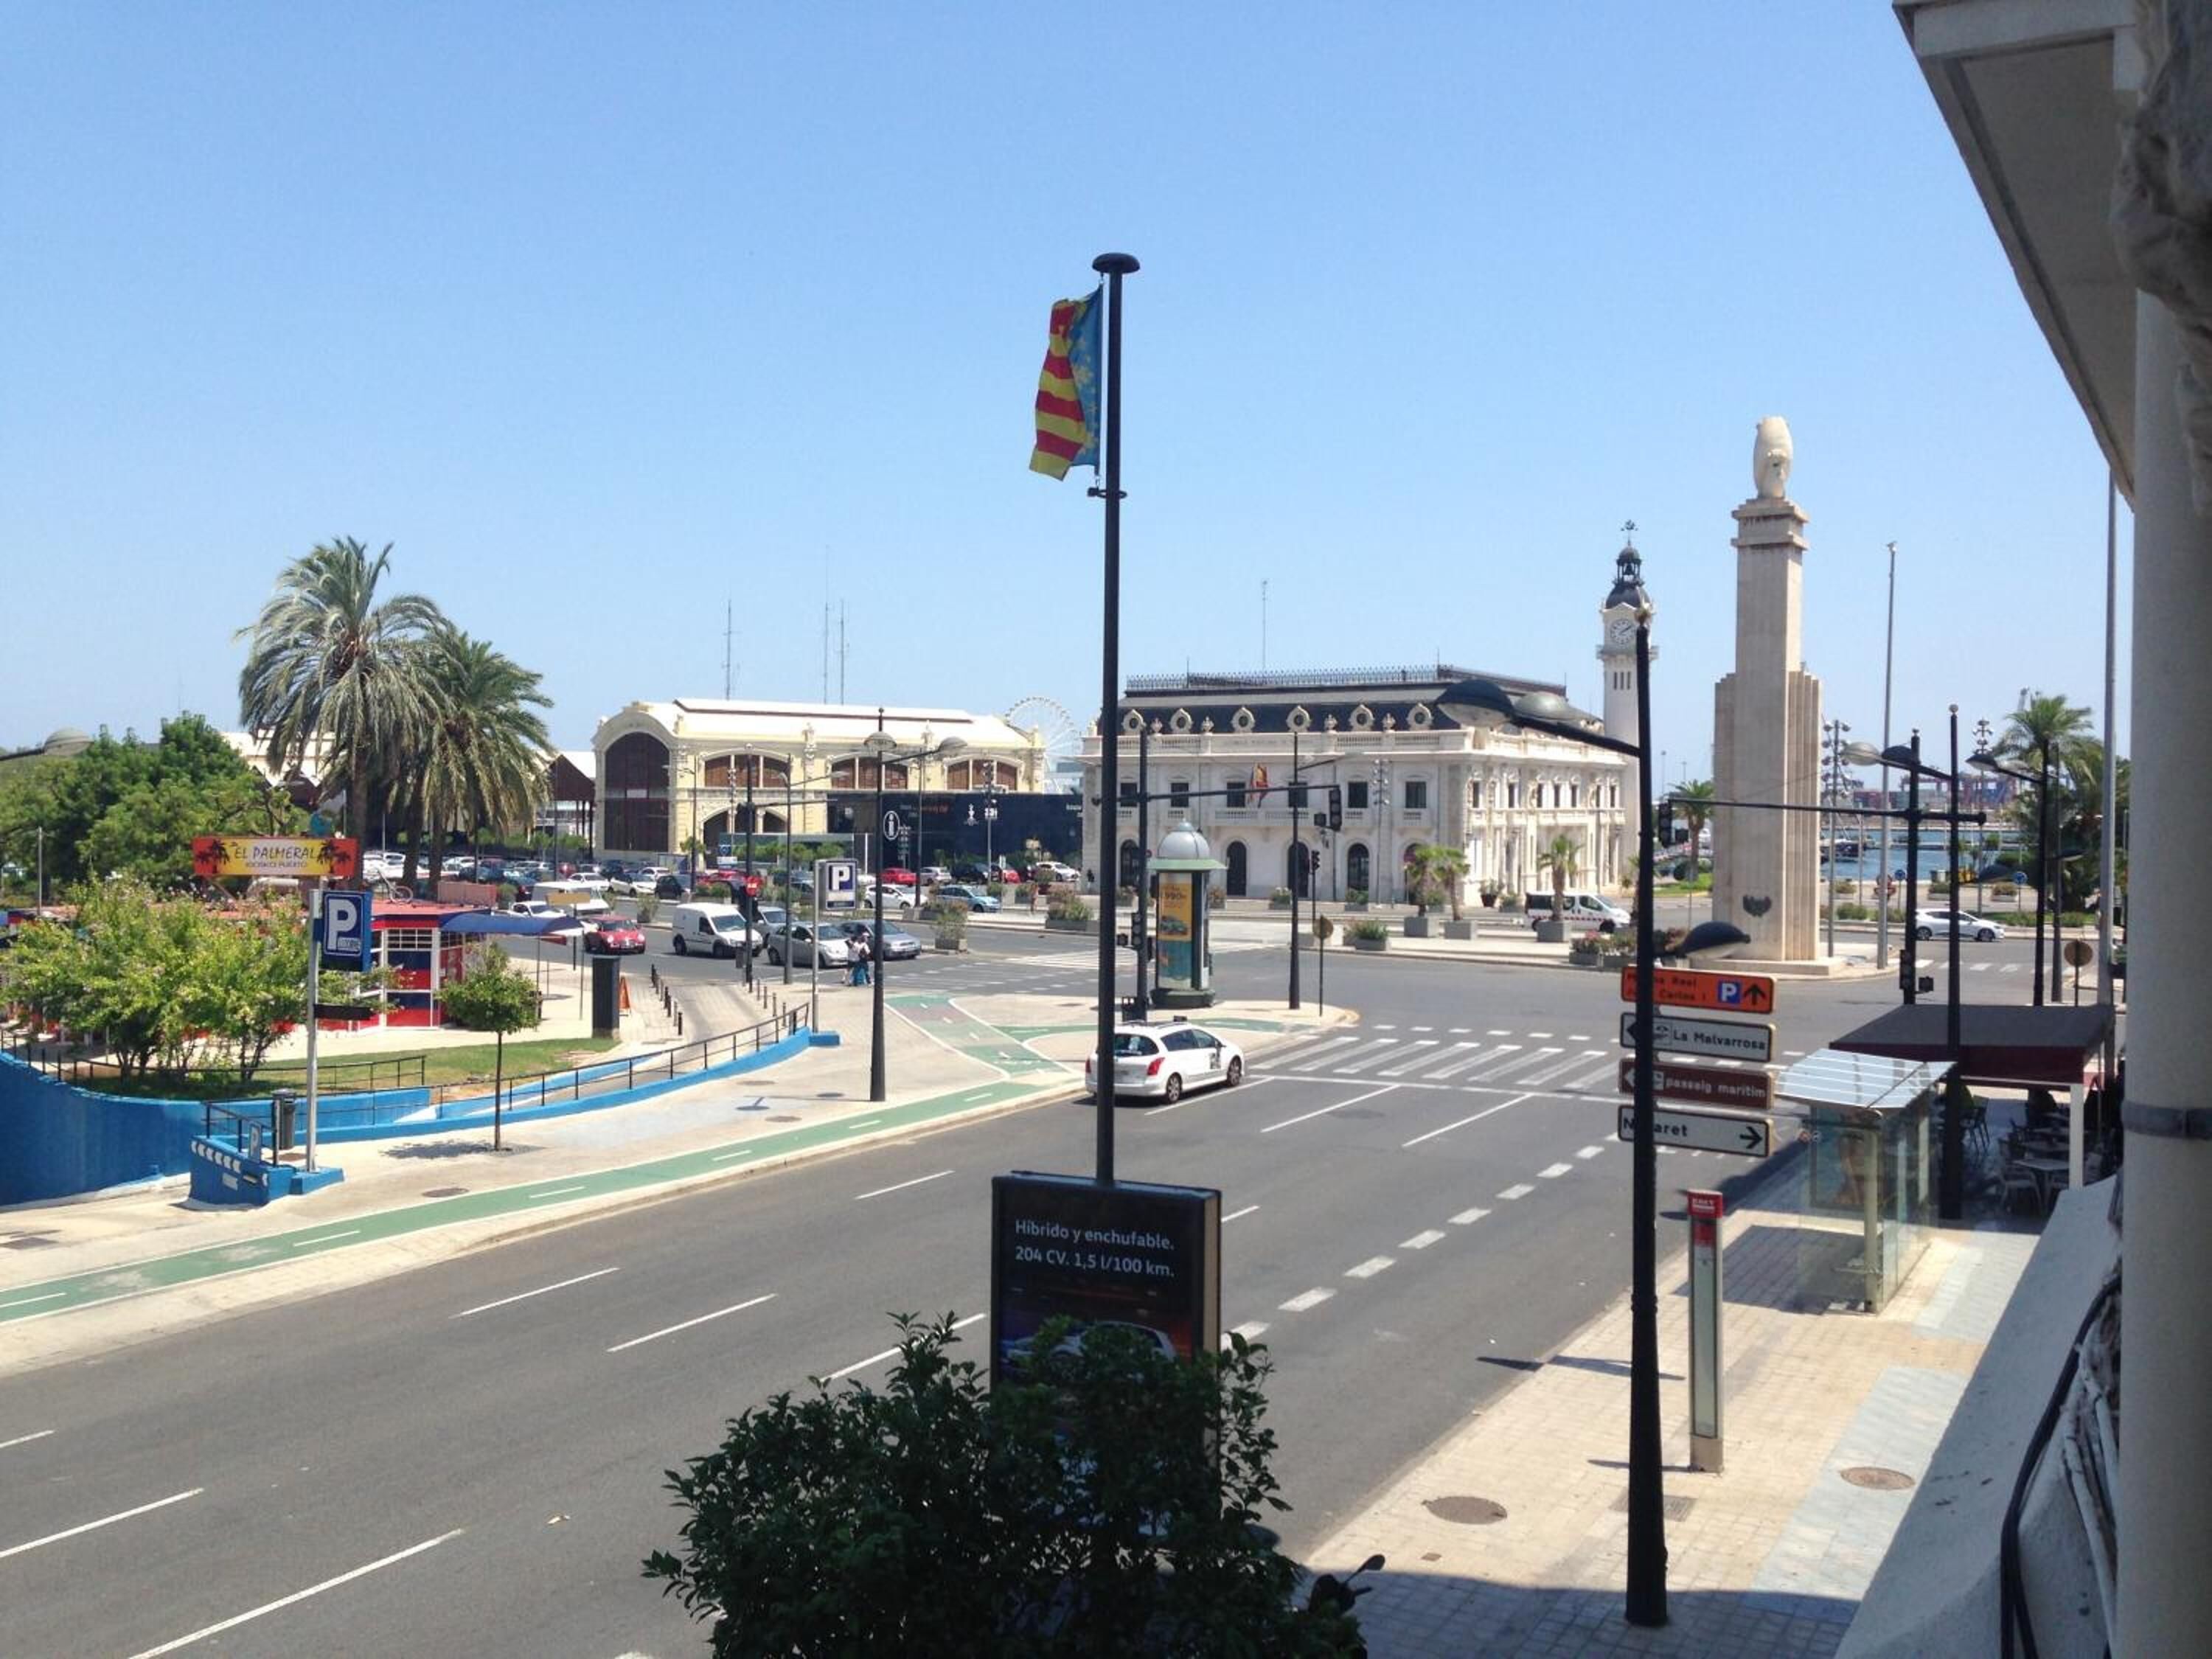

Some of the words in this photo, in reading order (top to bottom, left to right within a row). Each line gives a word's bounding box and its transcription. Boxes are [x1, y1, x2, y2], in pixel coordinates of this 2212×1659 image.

[235, 846, 248, 859] EL
[252, 846, 318, 860] PALMERAL
[832, 866, 850, 891] P
[327, 899, 358, 950] P
[1721, 982, 1736, 1002] P
[1673, 1029, 1688, 1042] La
[1694, 1033, 1766, 1051] Malvarrosa
[1624, 1118, 1688, 1137] Naret
[1072, 1228, 1082, 1243] y
[1084, 1228, 1175, 1251] enchufable.
[1015, 1245, 1043, 1262] 204
[1046, 1249, 1070, 1266] CV.
[1074, 1252, 1096, 1270] 1,5
[1146, 1259, 1175, 1277] km.
